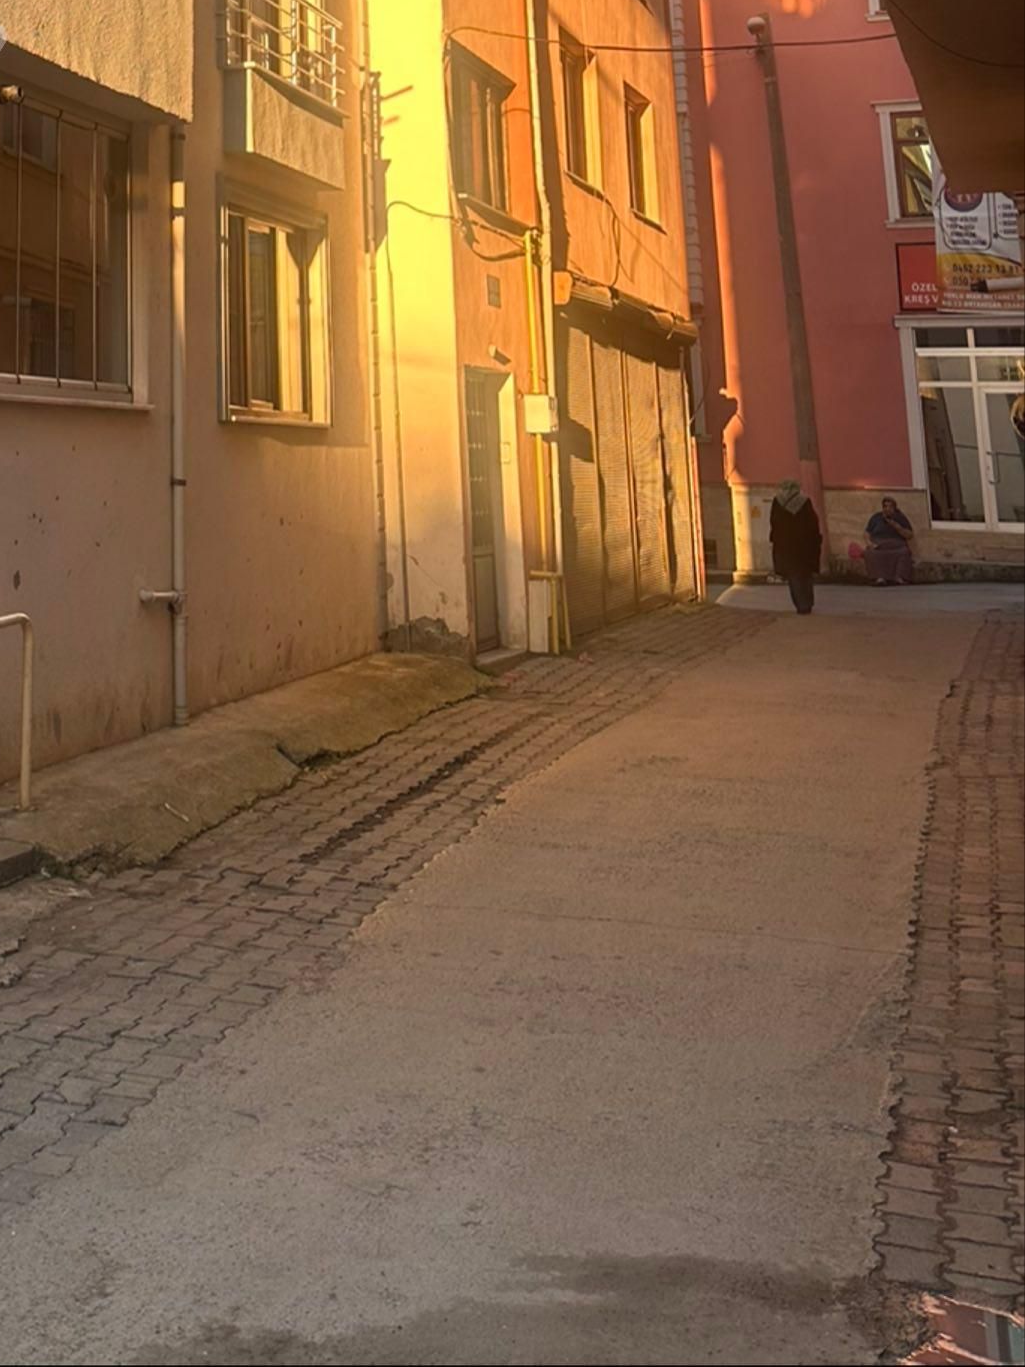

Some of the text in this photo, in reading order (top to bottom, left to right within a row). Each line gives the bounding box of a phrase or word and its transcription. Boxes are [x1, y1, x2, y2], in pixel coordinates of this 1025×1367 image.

[911, 281, 938, 292] ÖZEL
[904, 294, 940, 306] KREŞ V
